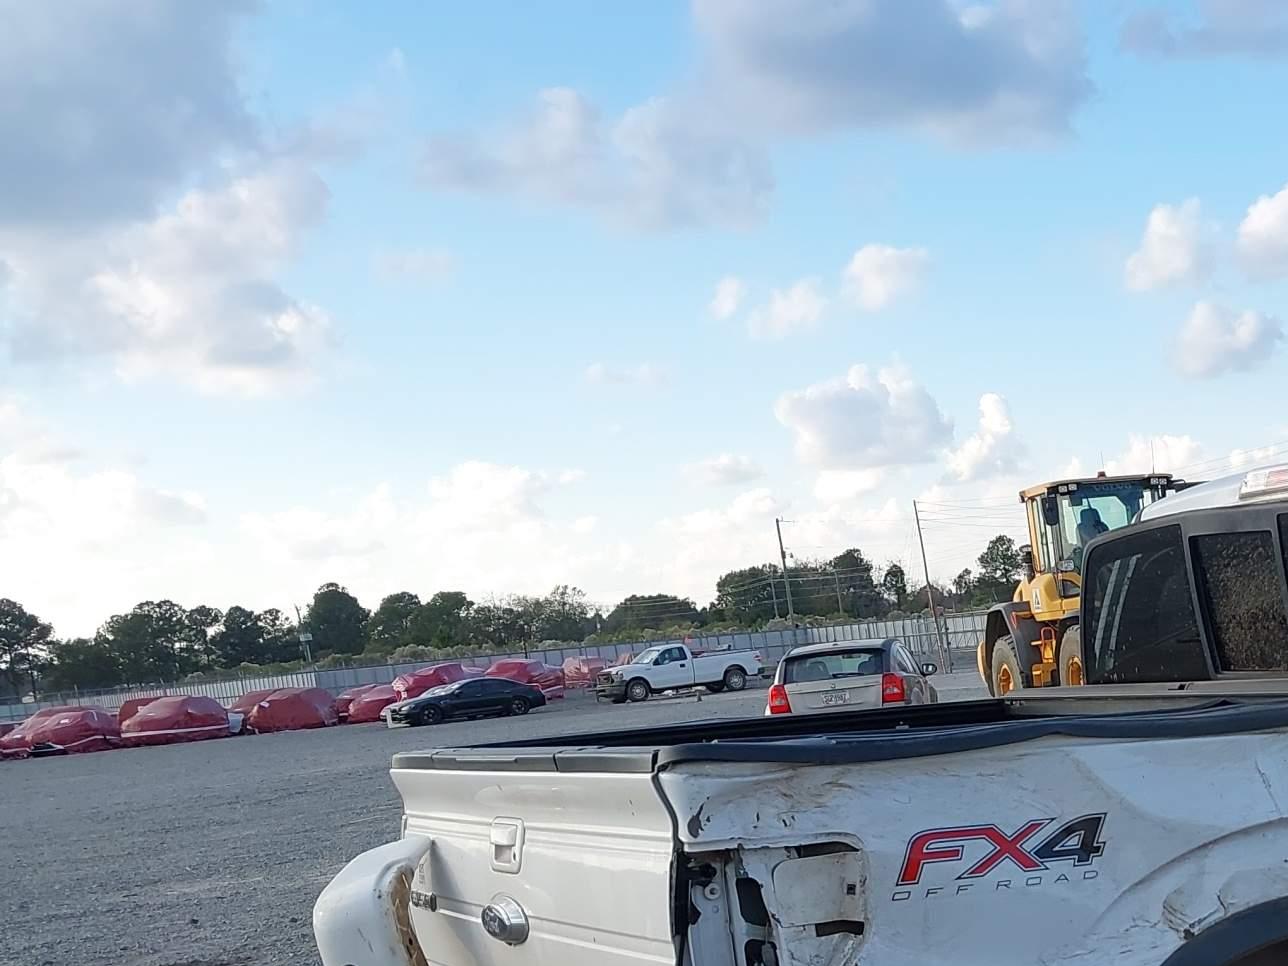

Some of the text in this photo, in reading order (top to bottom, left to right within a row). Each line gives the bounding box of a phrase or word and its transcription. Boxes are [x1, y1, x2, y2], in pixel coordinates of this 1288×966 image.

[896, 812, 1108, 887] FX4
[891, 870, 1099, 902] OFF ROAD
